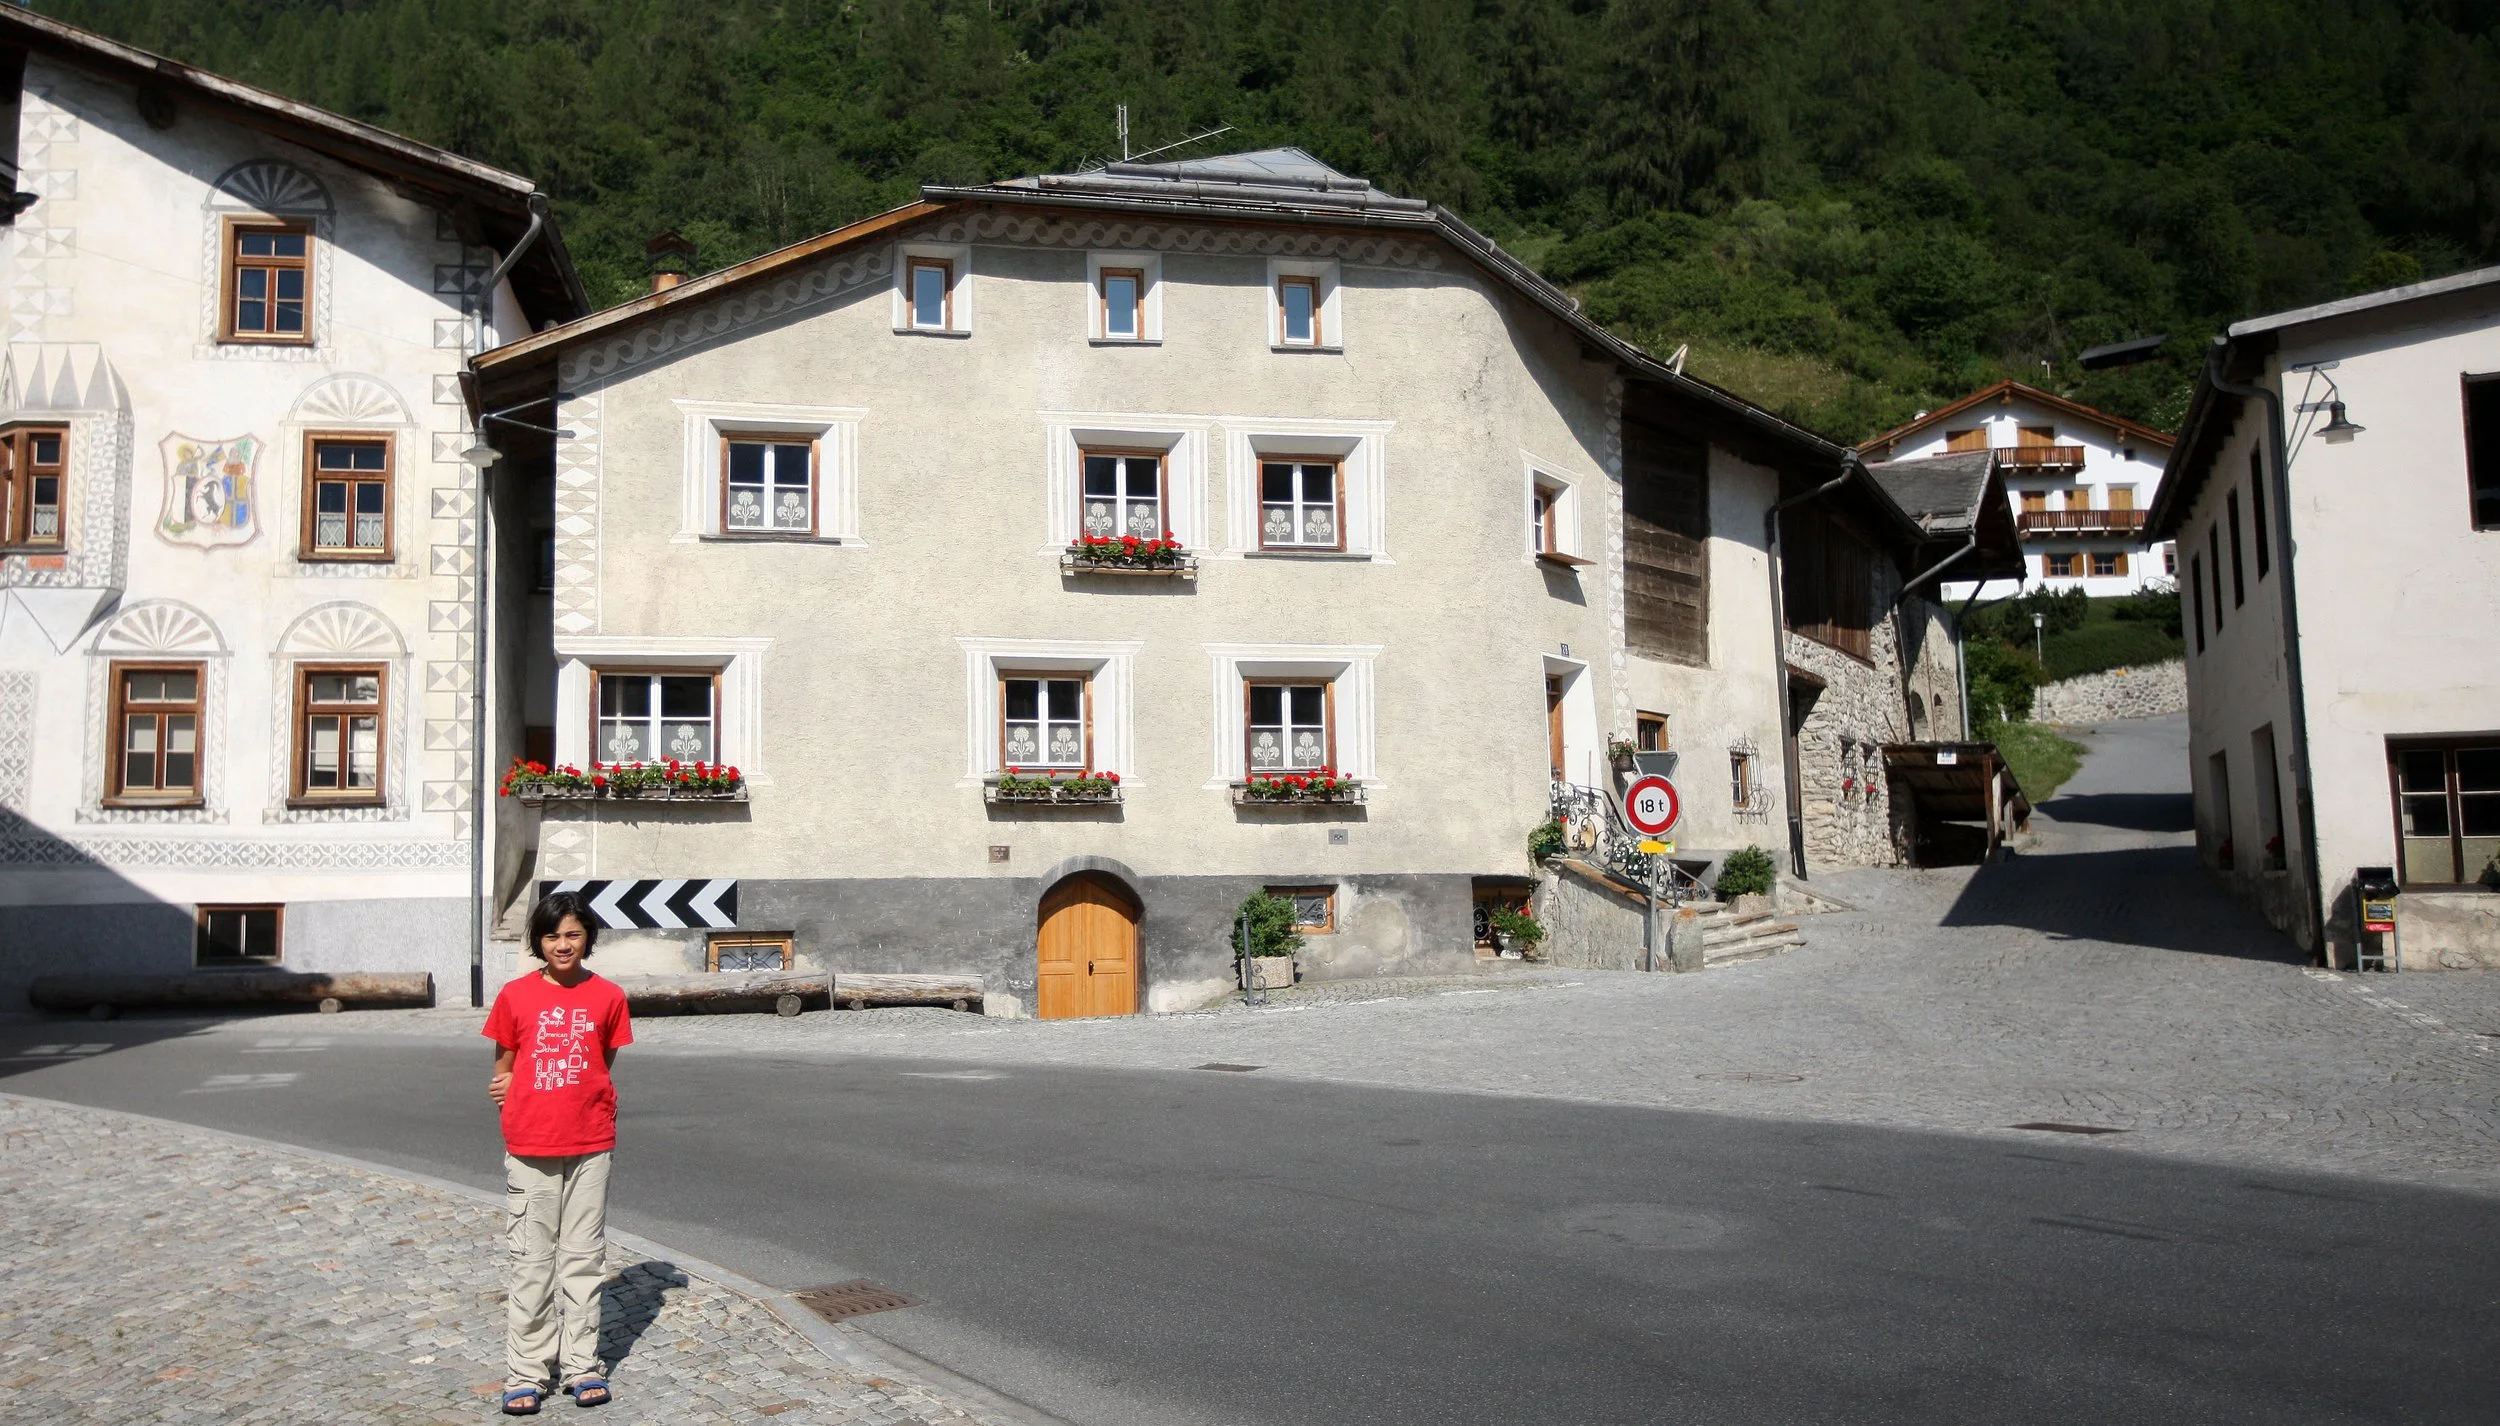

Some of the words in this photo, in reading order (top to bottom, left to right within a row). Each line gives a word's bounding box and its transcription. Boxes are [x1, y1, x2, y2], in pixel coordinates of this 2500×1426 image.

[1640, 799, 1655, 813] 18
[1658, 799, 1664, 812] t
[534, 1036, 561, 1053] School
